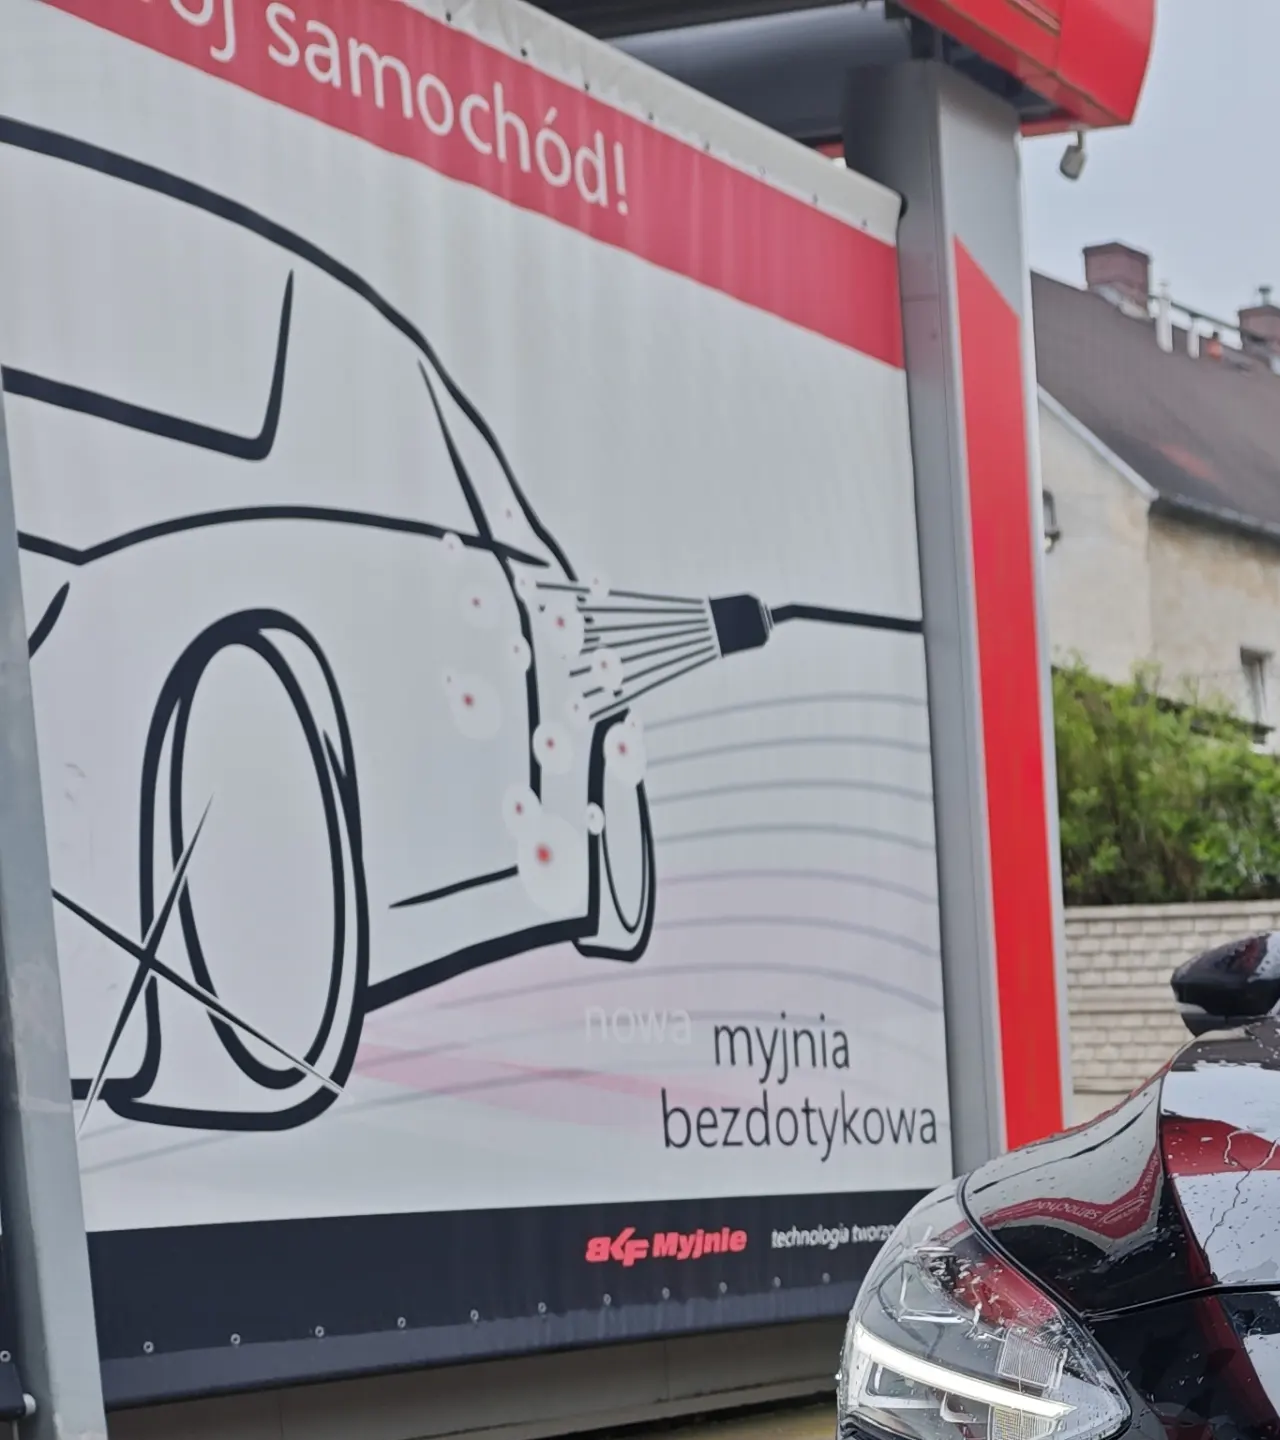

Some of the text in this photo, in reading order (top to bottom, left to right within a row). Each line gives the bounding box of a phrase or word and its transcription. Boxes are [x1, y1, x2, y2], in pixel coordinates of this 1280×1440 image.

[266, 2, 628, 216] samochód!
[584, 1005, 850, 1085] nowa myjnia
[661, 1087, 938, 1163] bezdotykowa
[585, 1226, 748, 1267] BKF Myjnie
[770, 1222, 850, 1250] technologia
